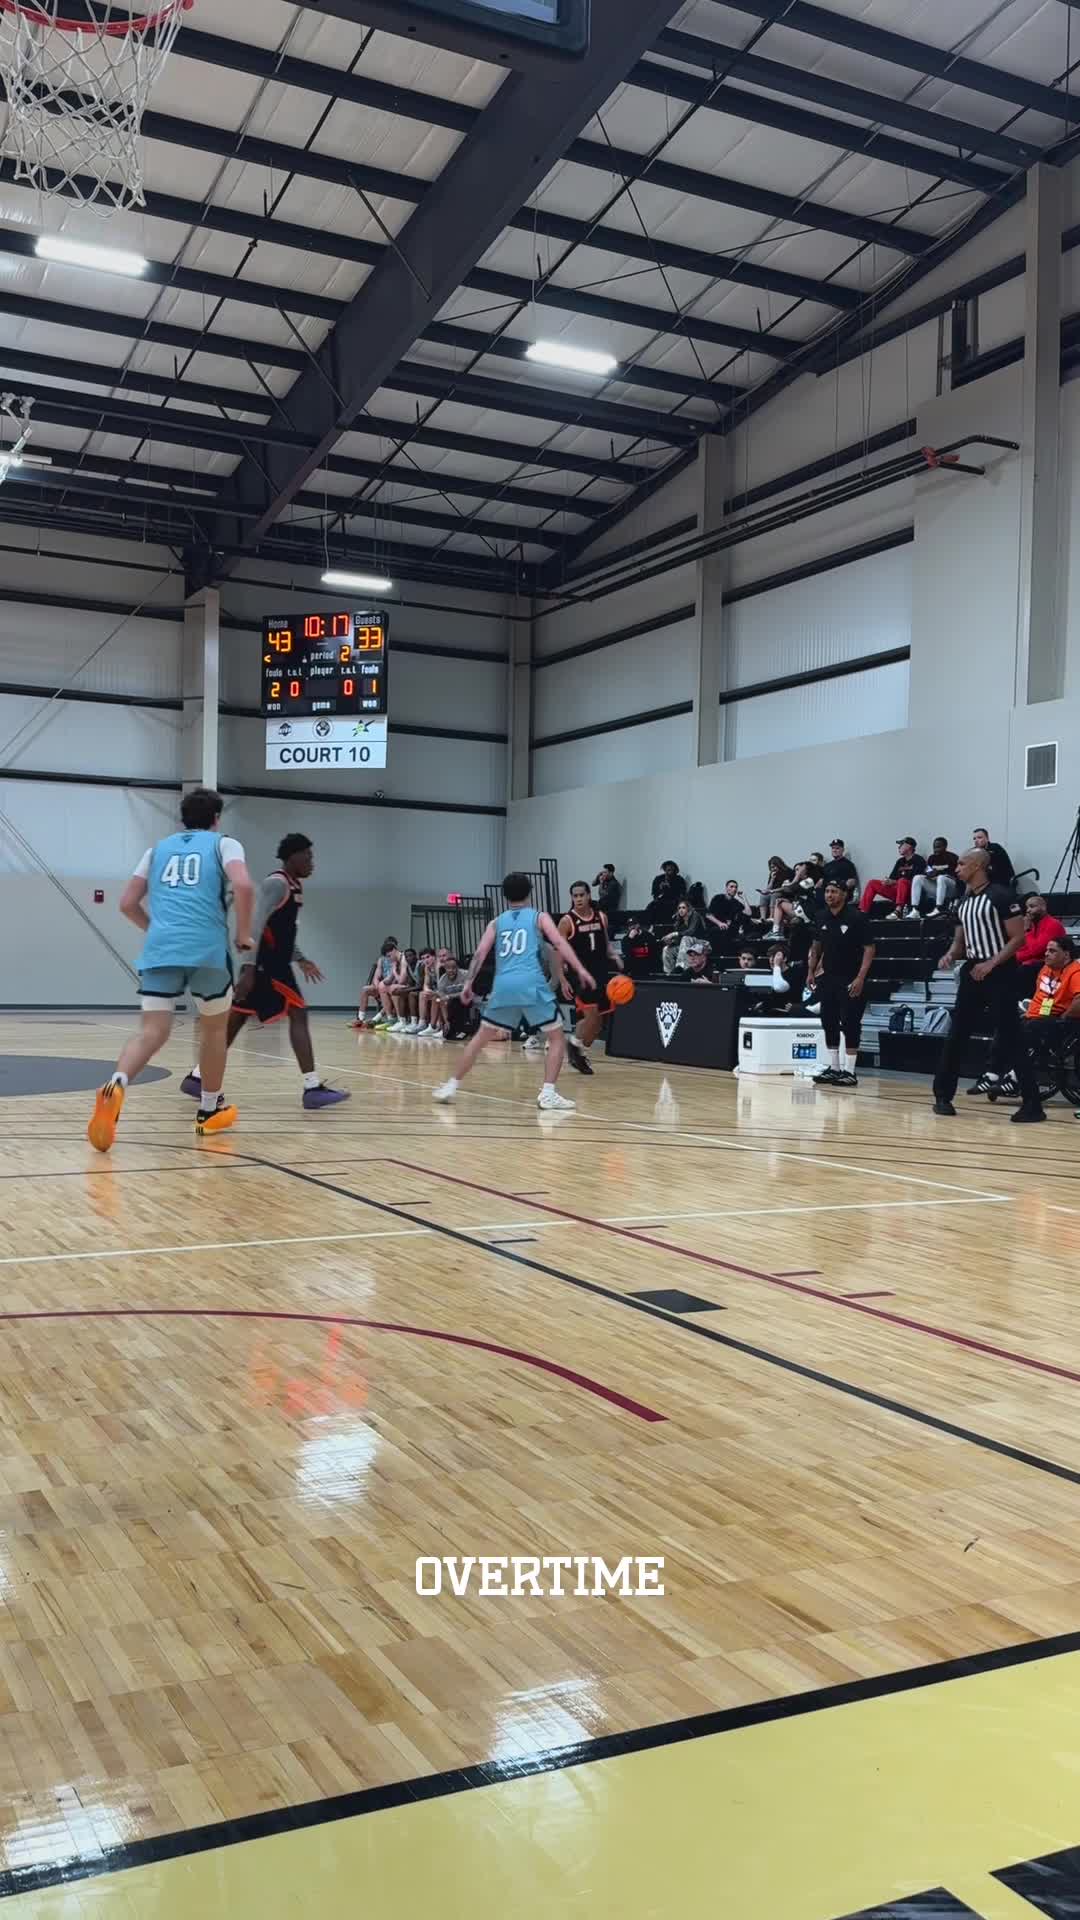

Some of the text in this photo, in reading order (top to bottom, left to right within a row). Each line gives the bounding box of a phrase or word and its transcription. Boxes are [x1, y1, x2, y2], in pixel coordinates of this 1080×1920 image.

[304, 614, 350, 637] 10:17
[268, 631, 292, 652] 43
[358, 627, 382, 649] 33
[340, 646, 350, 662] 2
[271, 682, 280, 697] 2
[290, 681, 300, 697] 0
[343, 679, 353, 695] 0
[371, 679, 377, 693] 1
[280, 747, 370, 763] COURT 10
[161, 853, 201, 888] 40
[499, 928, 528, 957] 30
[589, 933, 595, 951] 1
